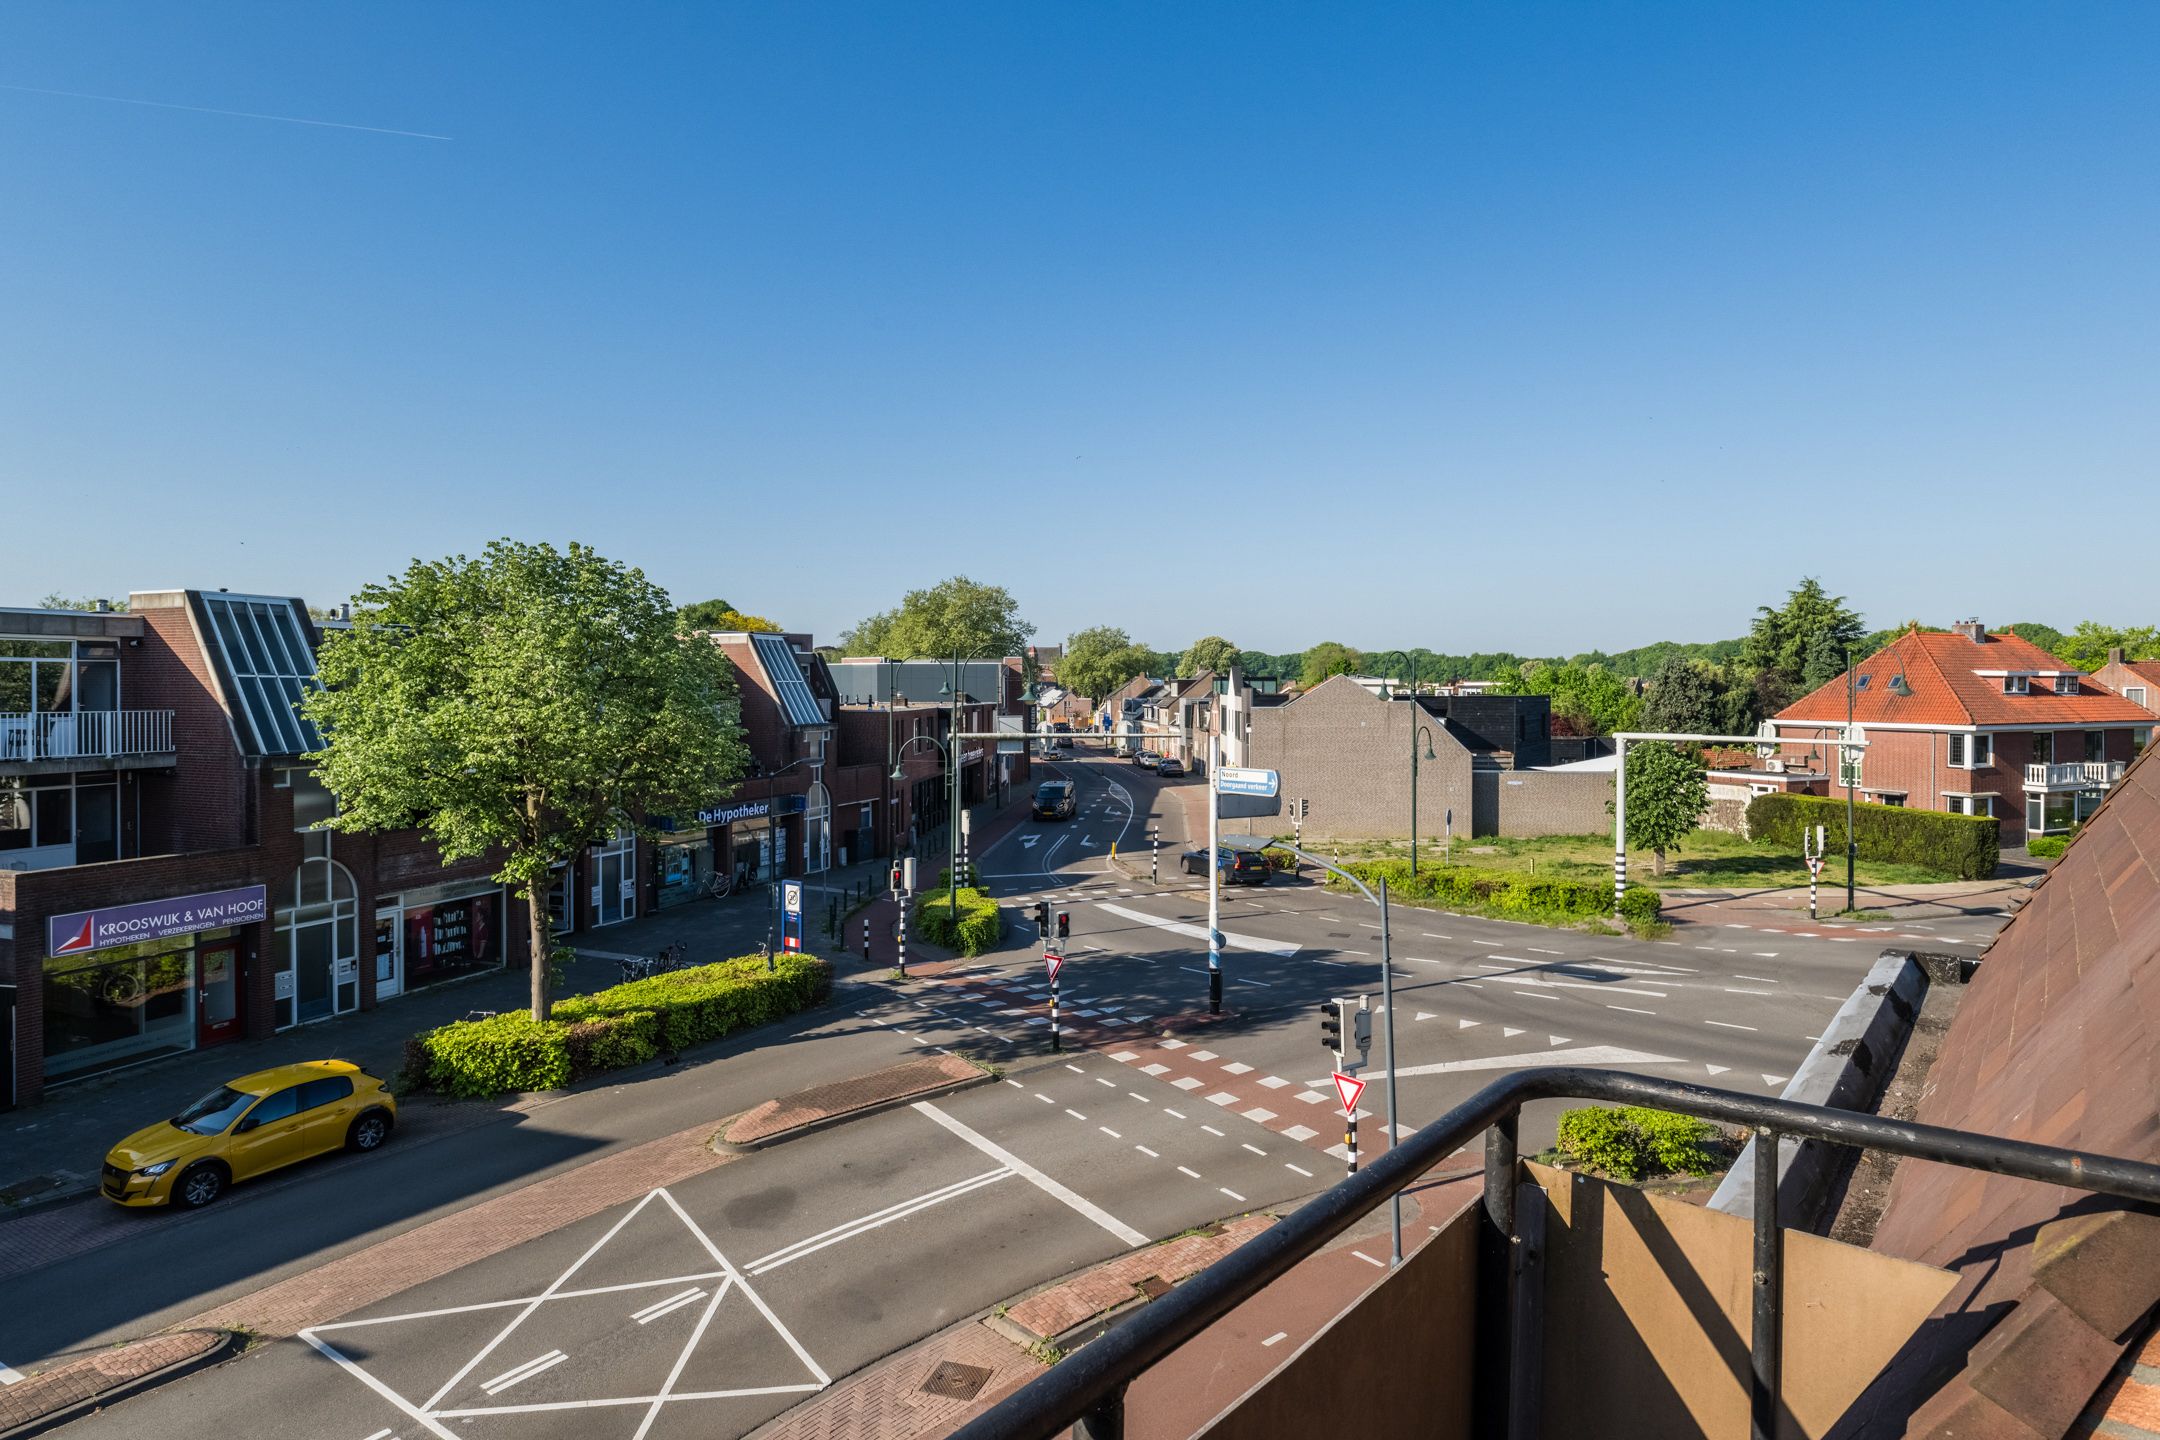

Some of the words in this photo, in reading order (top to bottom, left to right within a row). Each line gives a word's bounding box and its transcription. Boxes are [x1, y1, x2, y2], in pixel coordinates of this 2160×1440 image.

[1221, 781, 1247, 790] Doorgaand
[1247, 783, 1268, 791] verkeer
[699, 811, 713, 823] De
[714, 803, 769, 824] Hypotheker
[99, 912, 180, 937] KROOSWIJK
[184, 910, 194, 922] &
[197, 905, 224, 920] VAN
[228, 899, 264, 914] HOOF
[99, 932, 150, 947] HYPOTHEKEN
[158, 921, 215, 936] VERZEKERINGEN
[222, 912, 264, 925] PENSIOENEN
